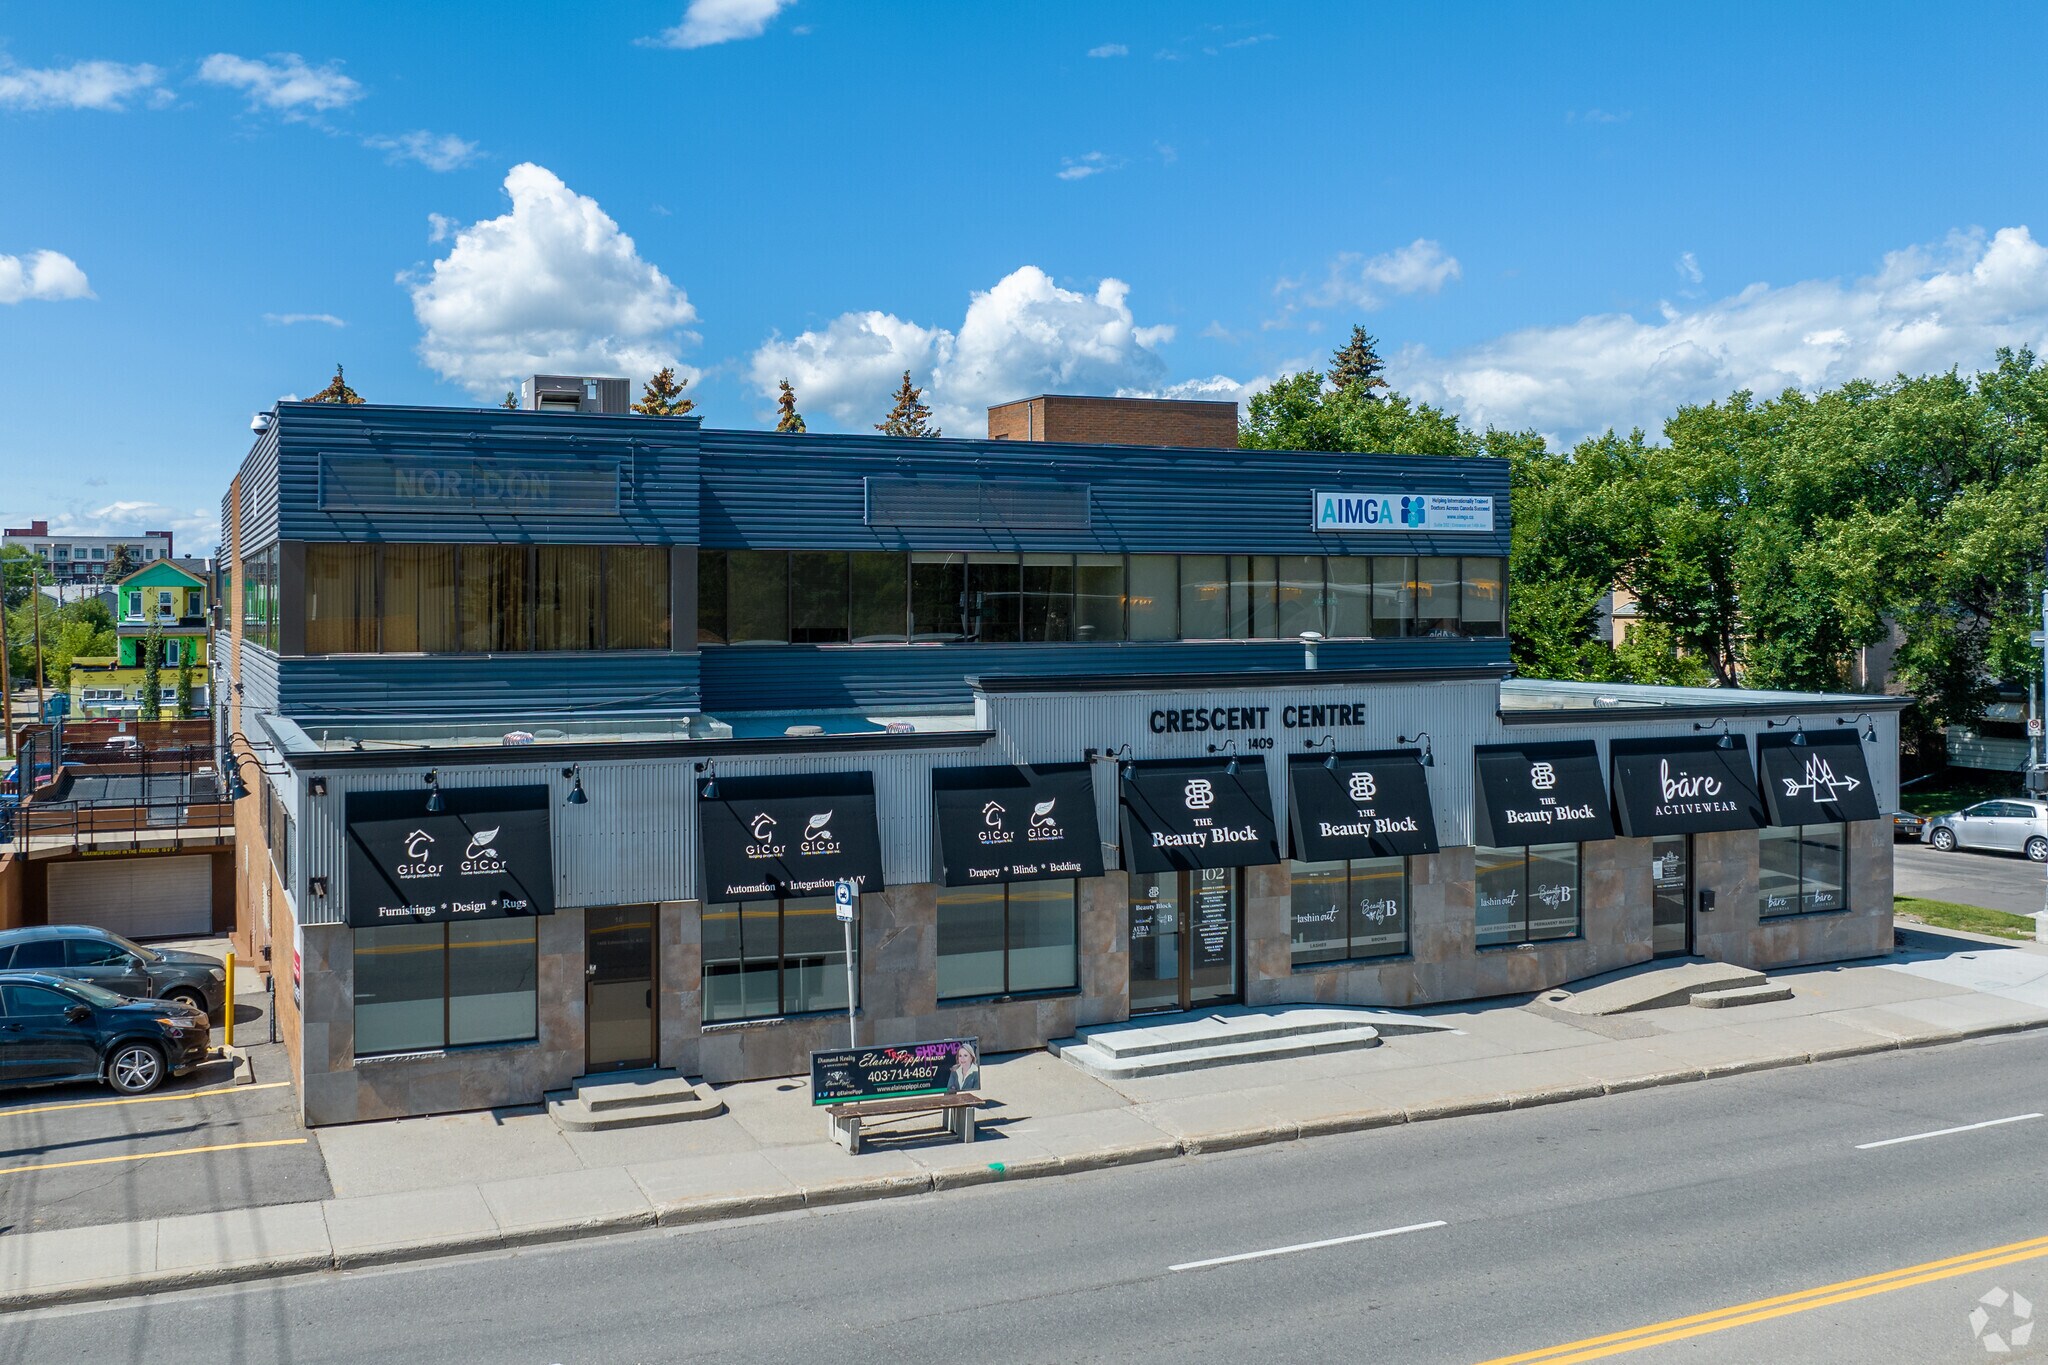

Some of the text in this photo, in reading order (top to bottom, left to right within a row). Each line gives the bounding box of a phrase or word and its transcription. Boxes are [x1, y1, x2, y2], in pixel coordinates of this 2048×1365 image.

[1321, 498, 1393, 524] AIMGA
[1149, 703, 1366, 734] CRESCENT CENTRE
[1247, 737, 1274, 750] 1409
[1660, 757, 1723, 803] bäre
[1539, 797, 1557, 806] THE
[1655, 801, 1738, 816] ACTIVEWEAR
[1357, 809, 1376, 818] THE
[1505, 804, 1595, 825] Beauty Block
[1193, 817, 1213, 827] THE
[1319, 816, 1418, 838] Beauty Block
[978, 830, 1015, 841] GiCor
[1028, 827, 1064, 838] GiCor
[1151, 825, 1258, 848] Beauty Block
[745, 844, 786, 855] GiCor
[800, 841, 841, 851] GiCor
[397, 863, 444, 875] GiCor
[460, 859, 507, 872] GiCor
[969, 861, 1081, 879] Drapery Blinds Bedding
[1201, 868, 1225, 881] 102
[726, 882, 776, 895] Automation
[790, 878, 835, 891] Integration
[1561, 886, 1571, 902] B
[378, 899, 527, 918] Furnishings Design Rugs
[1386, 900, 1397, 917] B
[817, 1054, 856, 1064] Diamond Realty
[858, 1052, 895, 1067] Elaine
[876, 1082, 931, 1093] www.elainepippi.com
